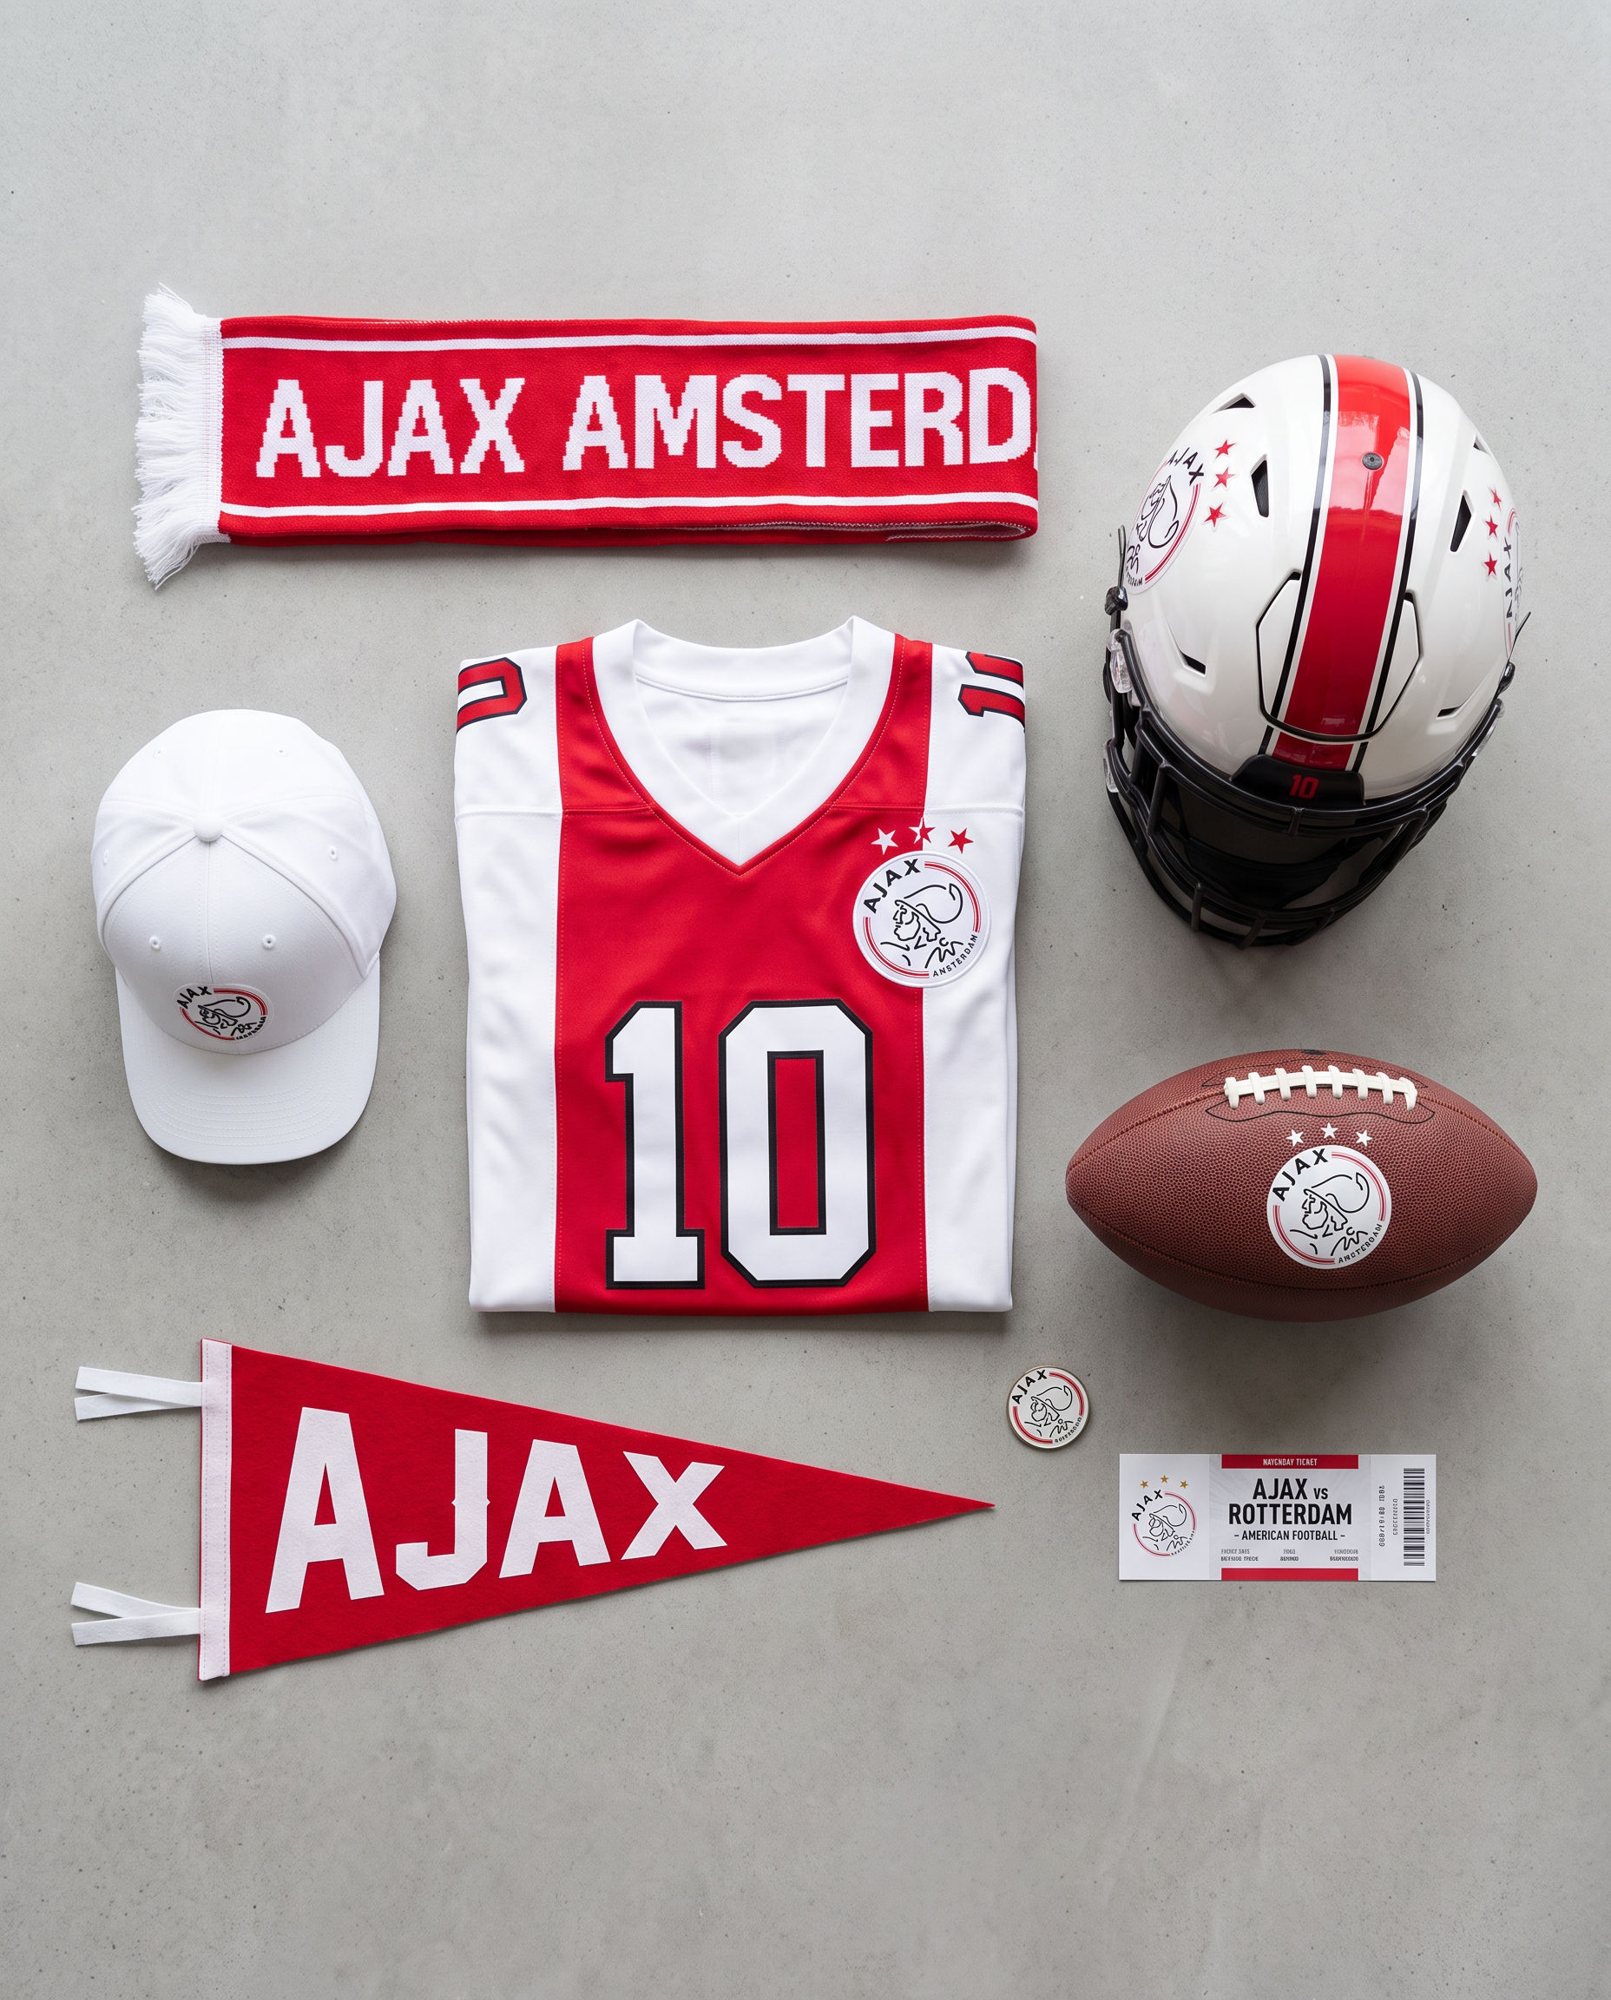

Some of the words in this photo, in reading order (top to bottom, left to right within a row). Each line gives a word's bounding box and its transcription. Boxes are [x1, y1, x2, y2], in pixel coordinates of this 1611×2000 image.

[256, 378, 526, 478] AJAX
[562, 367, 1038, 471] AMSTERD
[1167, 447, 1204, 486] AJAX
[1290, 774, 1319, 799] 10
[863, 858, 920, 914] AJAX
[605, 1000, 878, 1290] 10
[1272, 1148, 1328, 1201] AJAX
[1012, 1369, 1047, 1404] AJAX
[1131, 1489, 1163, 1521] AJAX
[1252, 1478, 1308, 1500] AJAX
[265, 1406, 726, 1613] AJAX
[1228, 1503, 1352, 1525] ROTTERDAM
[1241, 1530, 1290, 1541] AMERICAN
[1292, 1530, 1338, 1541] FOOTBALL
